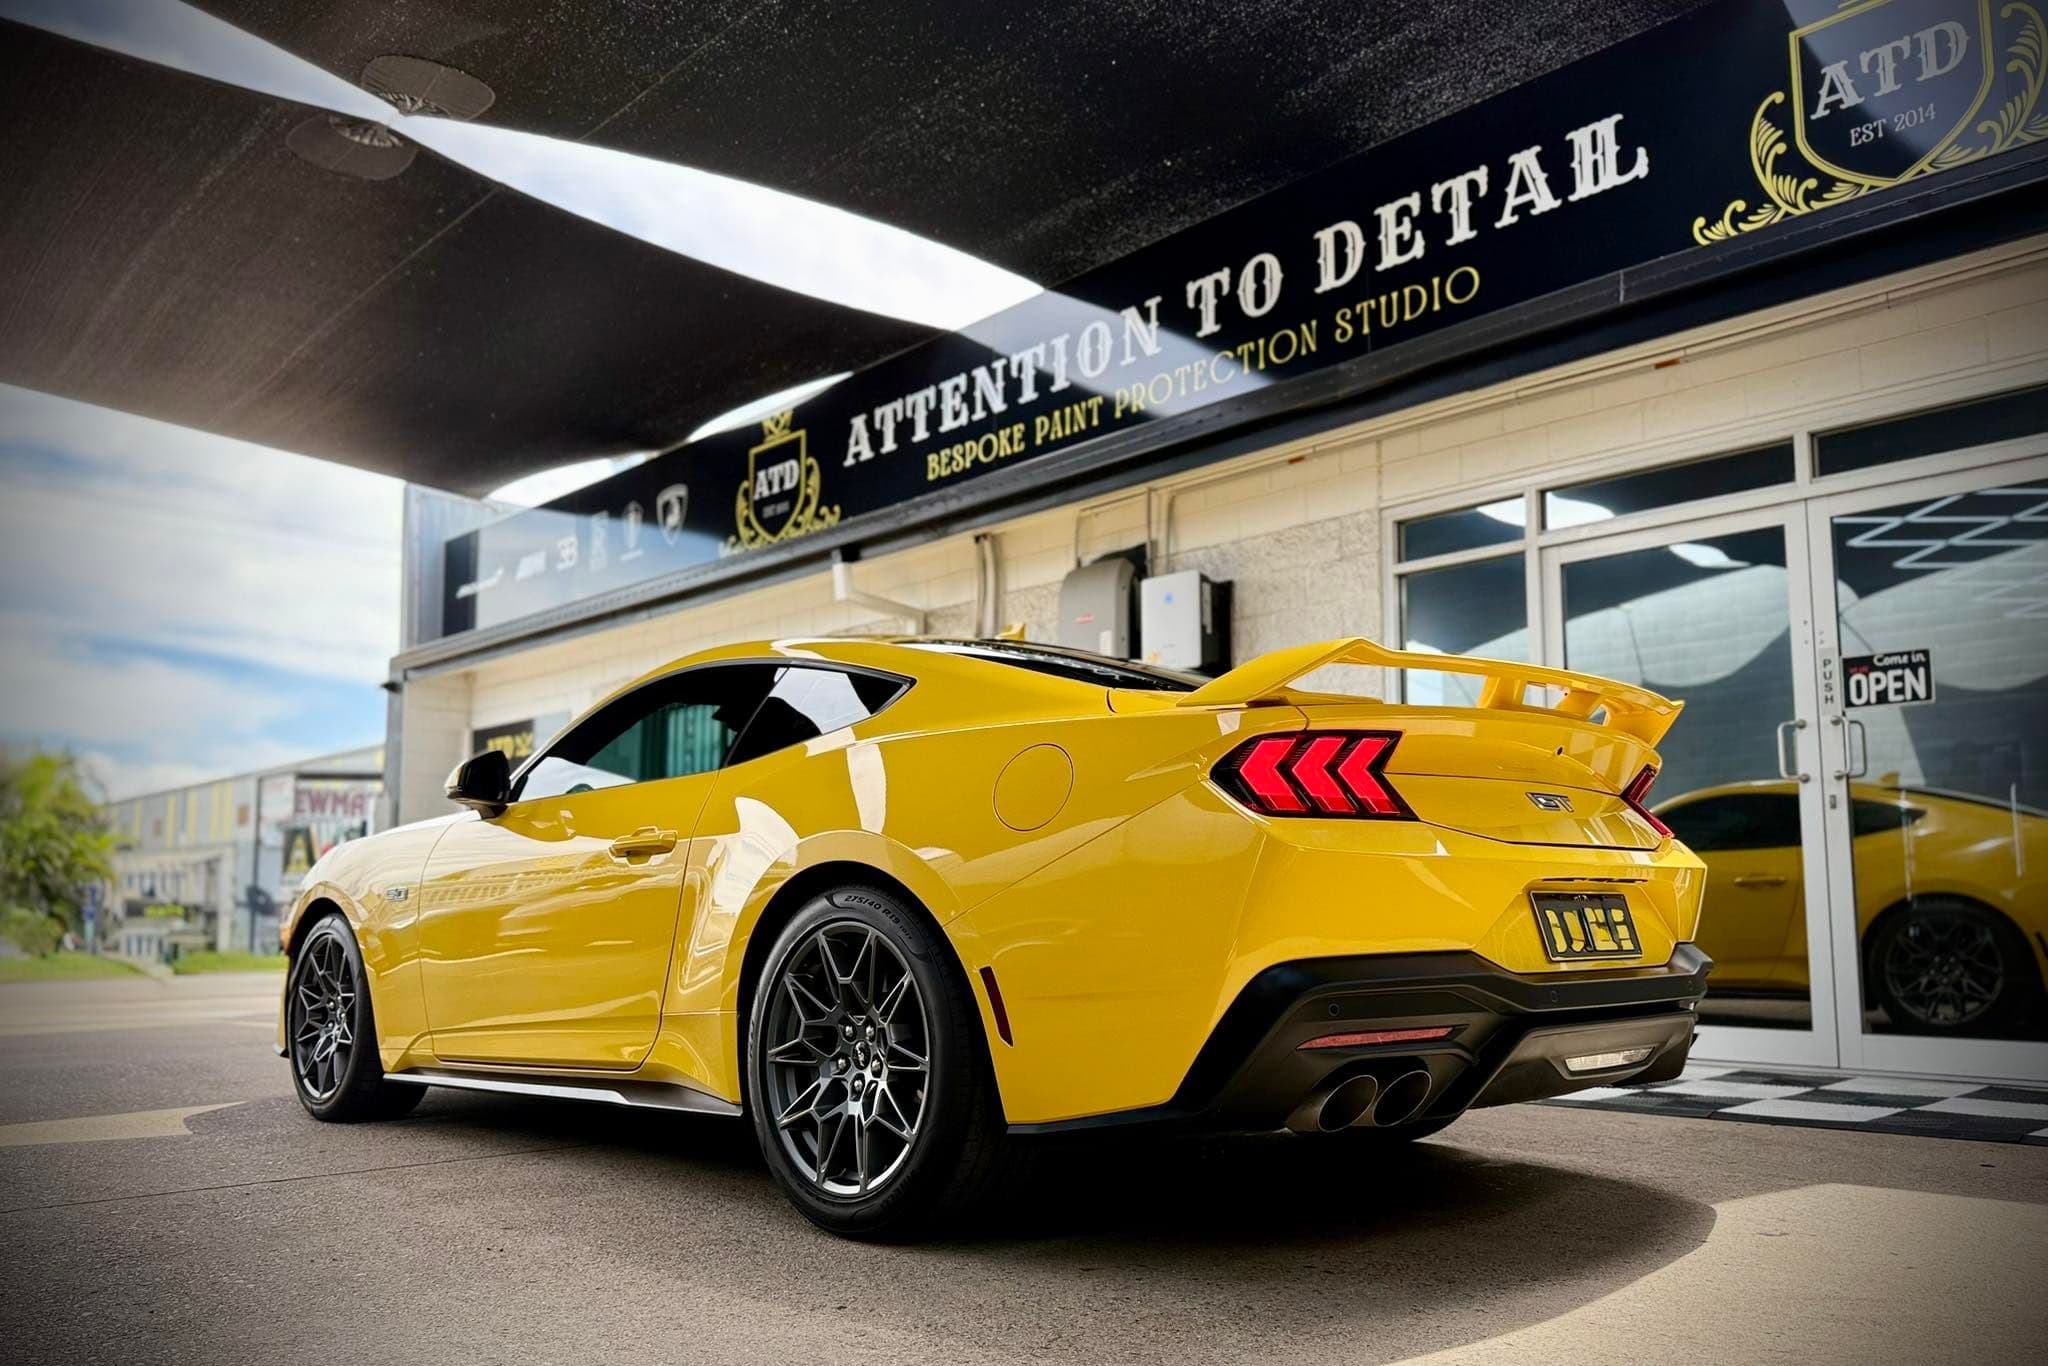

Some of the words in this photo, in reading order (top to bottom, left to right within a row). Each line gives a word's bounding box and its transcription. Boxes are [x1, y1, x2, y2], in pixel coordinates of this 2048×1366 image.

[1810, 21, 1970, 119] ATD
[1850, 118, 1887, 147] EST
[1893, 103, 1937, 132] 2014
[843, 296, 1163, 467] ATTENTION
[1186, 253, 1284, 336] TO
[1314, 114, 1650, 293] DETAIL
[926, 425, 1026, 481] BESPOKE
[1034, 397, 1103, 446] PAINT
[1113, 321, 1319, 419] PROTECTION
[1336, 266, 1481, 344] STUDIO
[753, 459, 800, 501] ATD
[1823, 659, 1834, 704] PUSH
[1874, 655, 1909, 667] Come
[1911, 652, 1926, 662] in
[1849, 667, 1927, 705] OPEN
[845, 895, 882, 910] 275/40
[882, 908, 900, 924] R19
